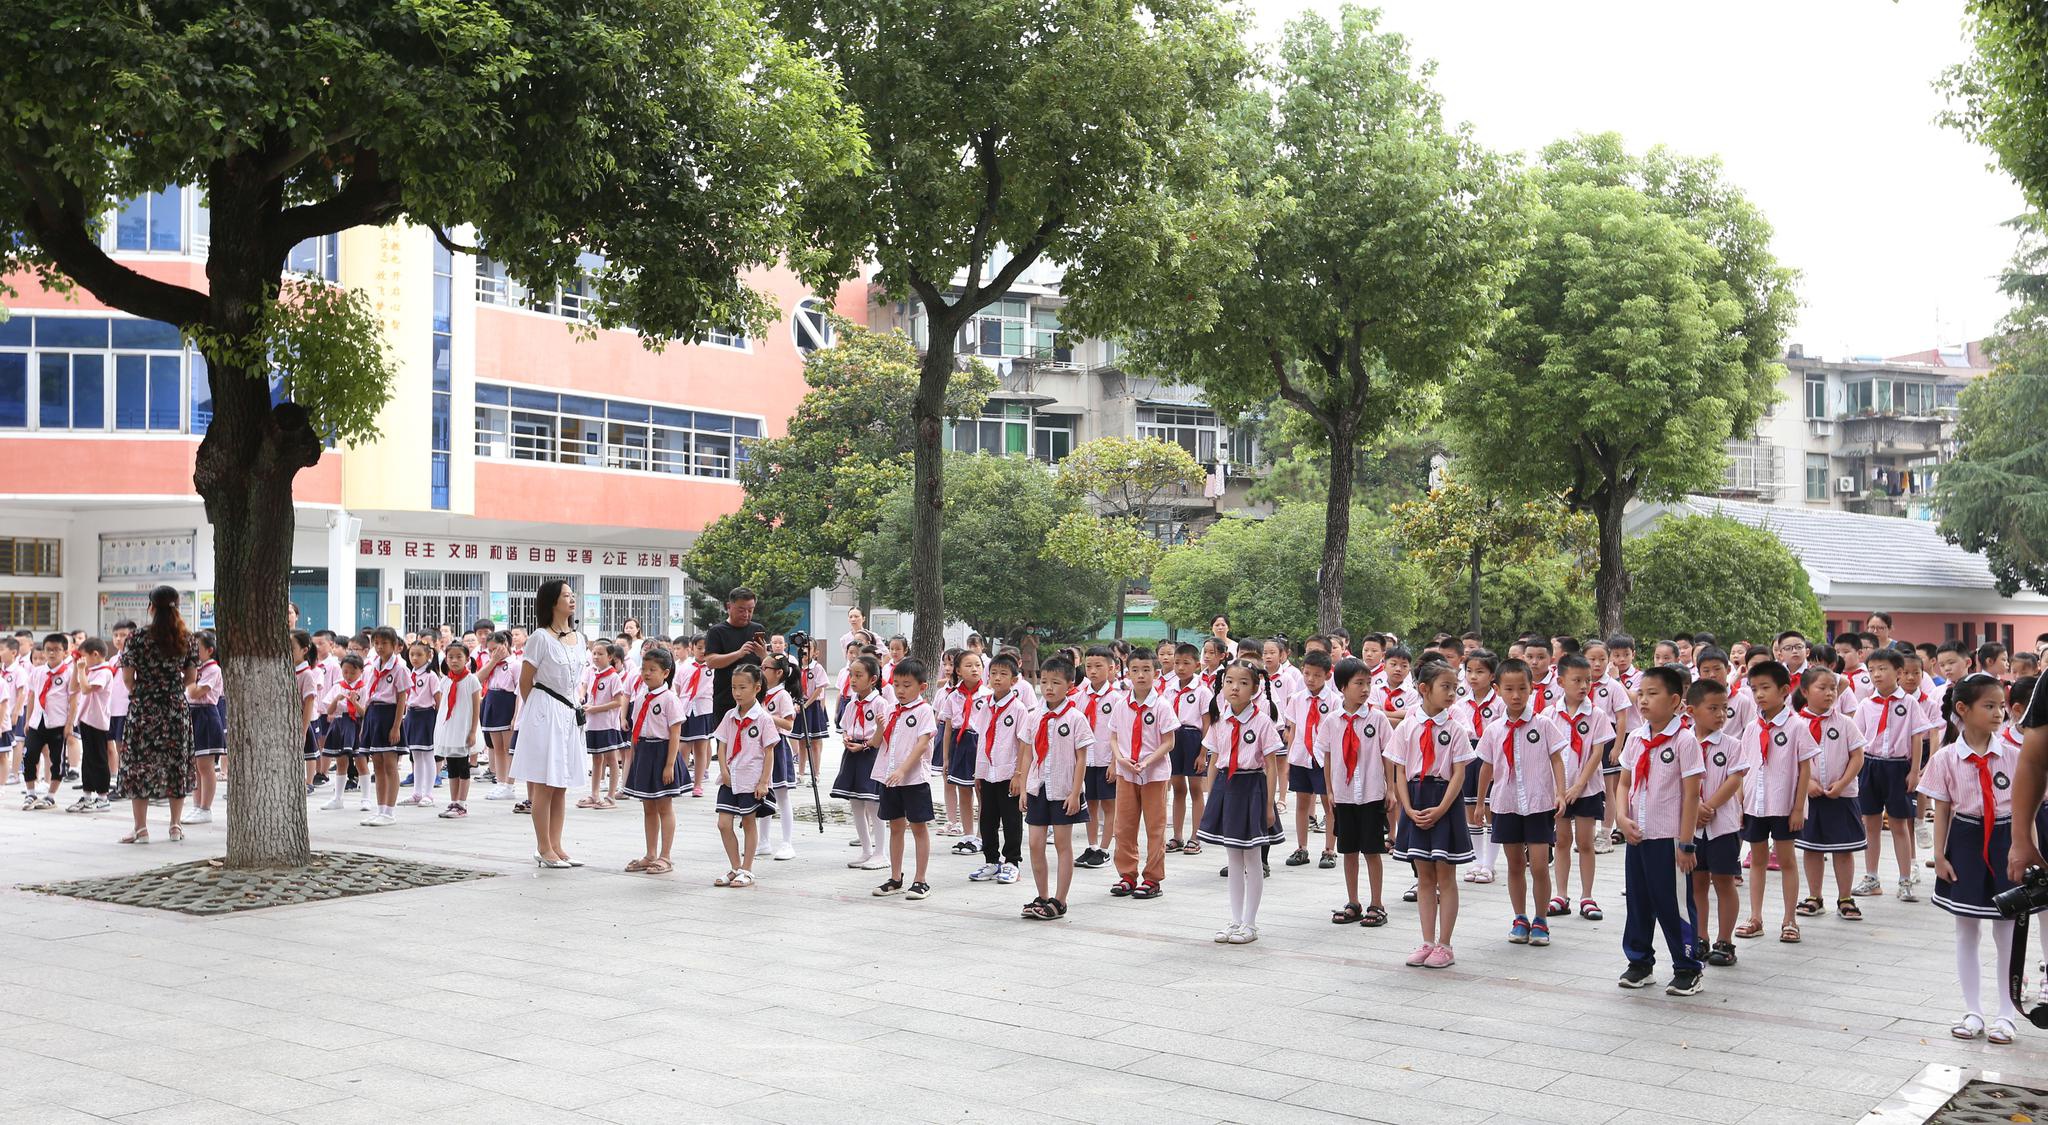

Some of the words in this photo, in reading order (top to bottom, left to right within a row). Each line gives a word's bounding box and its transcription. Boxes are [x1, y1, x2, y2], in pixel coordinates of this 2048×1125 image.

[405, 541, 435, 558] 民主
[448, 543, 478, 559] 文明
[490, 545, 518, 561] 和谐
[529, 547, 556, 562] 自由
[567, 549, 592, 564] 平等
[603, 551, 627, 566] 公正
[638, 553, 662, 567] 法治
